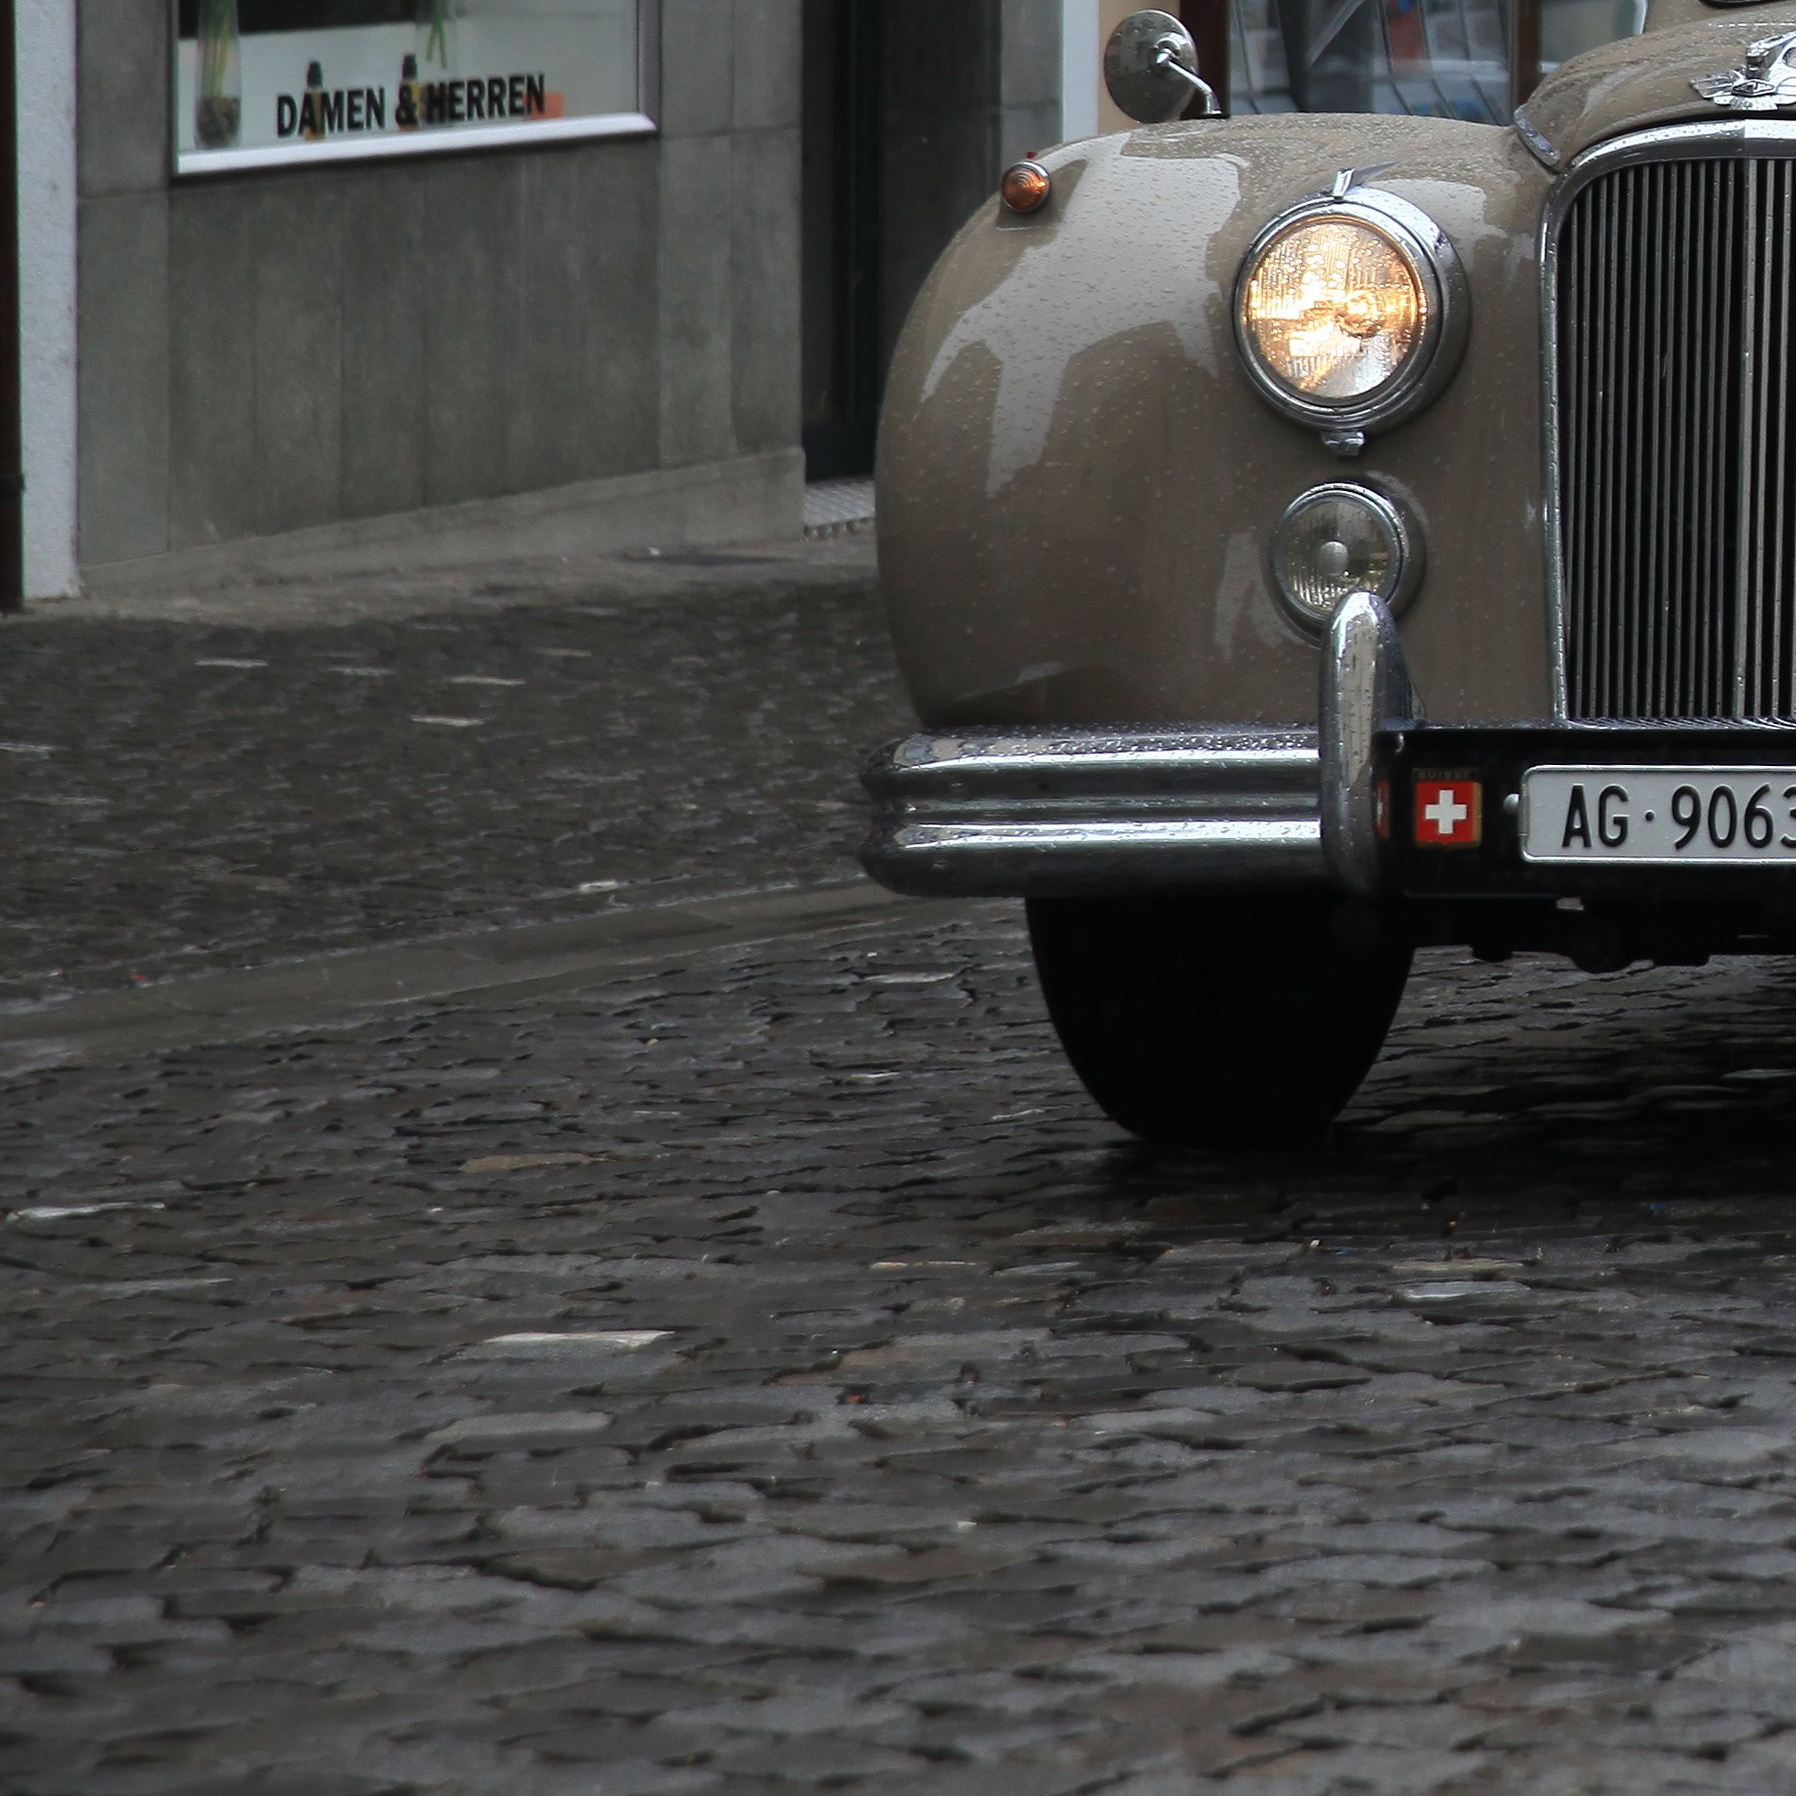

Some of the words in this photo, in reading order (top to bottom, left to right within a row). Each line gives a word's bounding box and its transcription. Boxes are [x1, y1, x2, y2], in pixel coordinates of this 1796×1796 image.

[277, 87, 386, 139] DAMEN
[395, 85, 421, 132] &
[425, 73, 546, 126] HERREN
